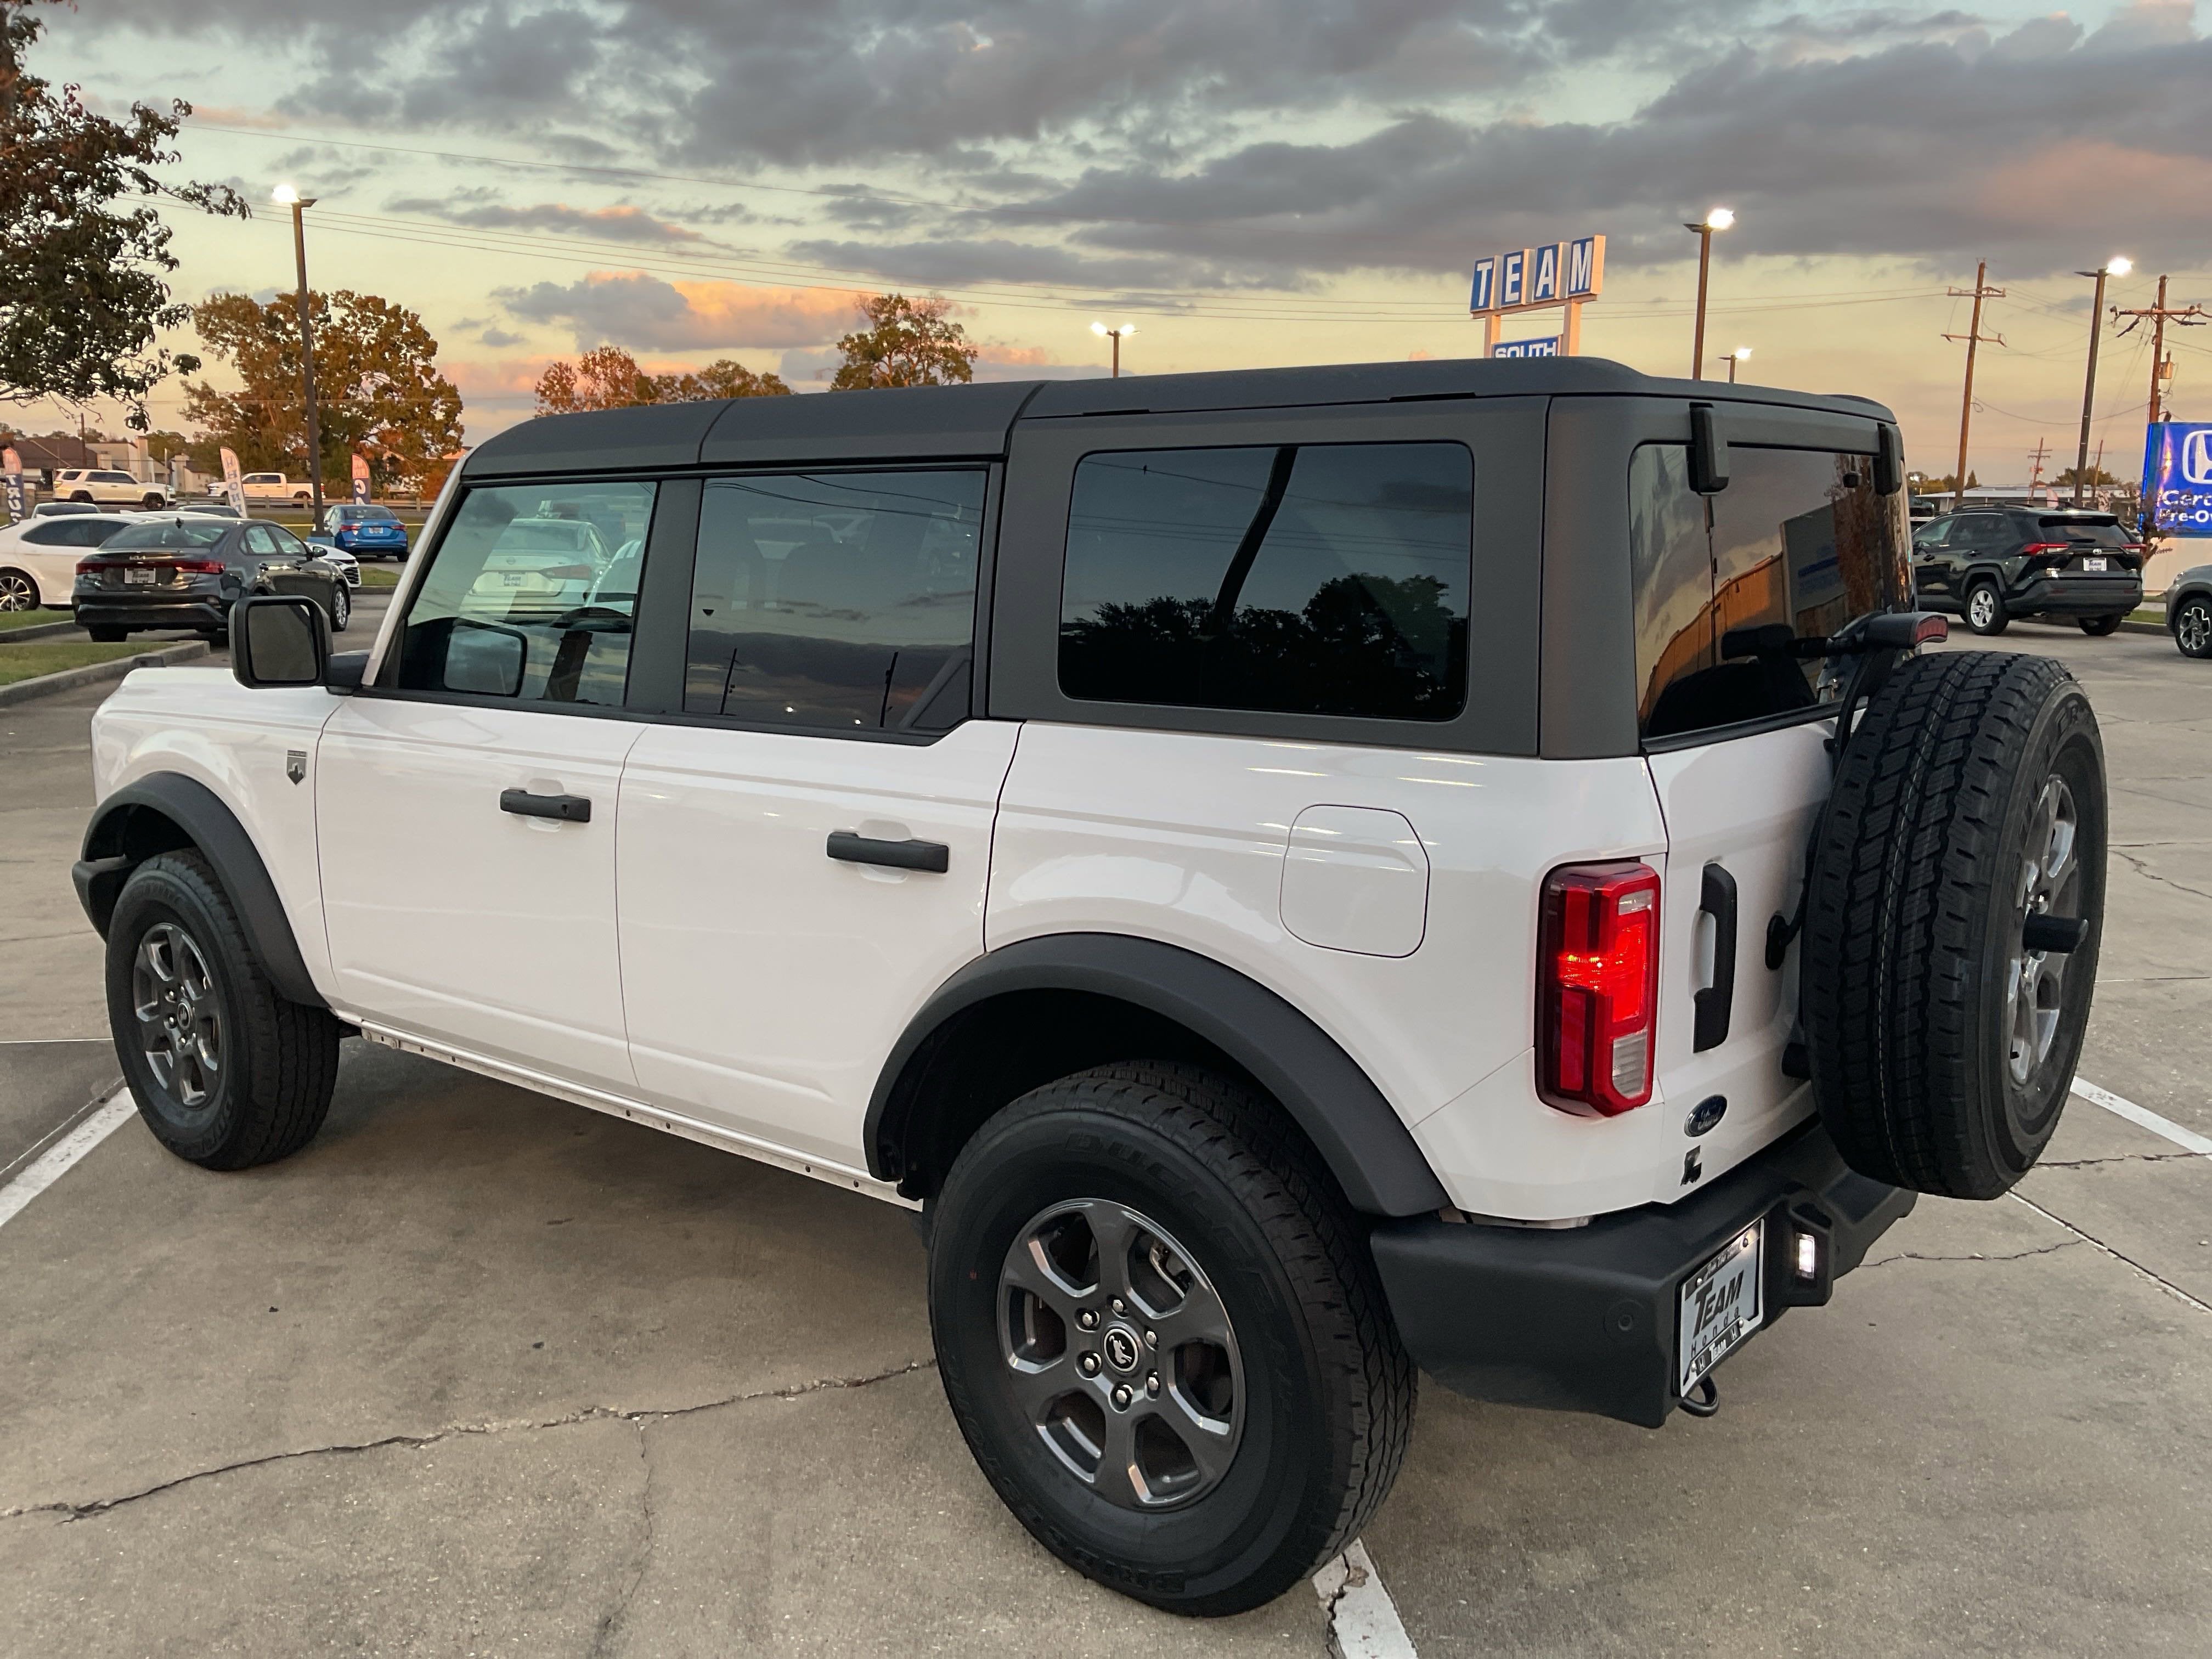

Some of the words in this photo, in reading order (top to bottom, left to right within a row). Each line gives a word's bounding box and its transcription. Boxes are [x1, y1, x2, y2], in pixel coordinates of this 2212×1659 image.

[1477, 240, 1594, 307] TEAM
[1495, 341, 1557, 358] SOUTH
[1693, 1269, 1744, 1339] TEAM
[1691, 1306, 1739, 1359] Honda
[1709, 1339, 1727, 1362] TEAM
